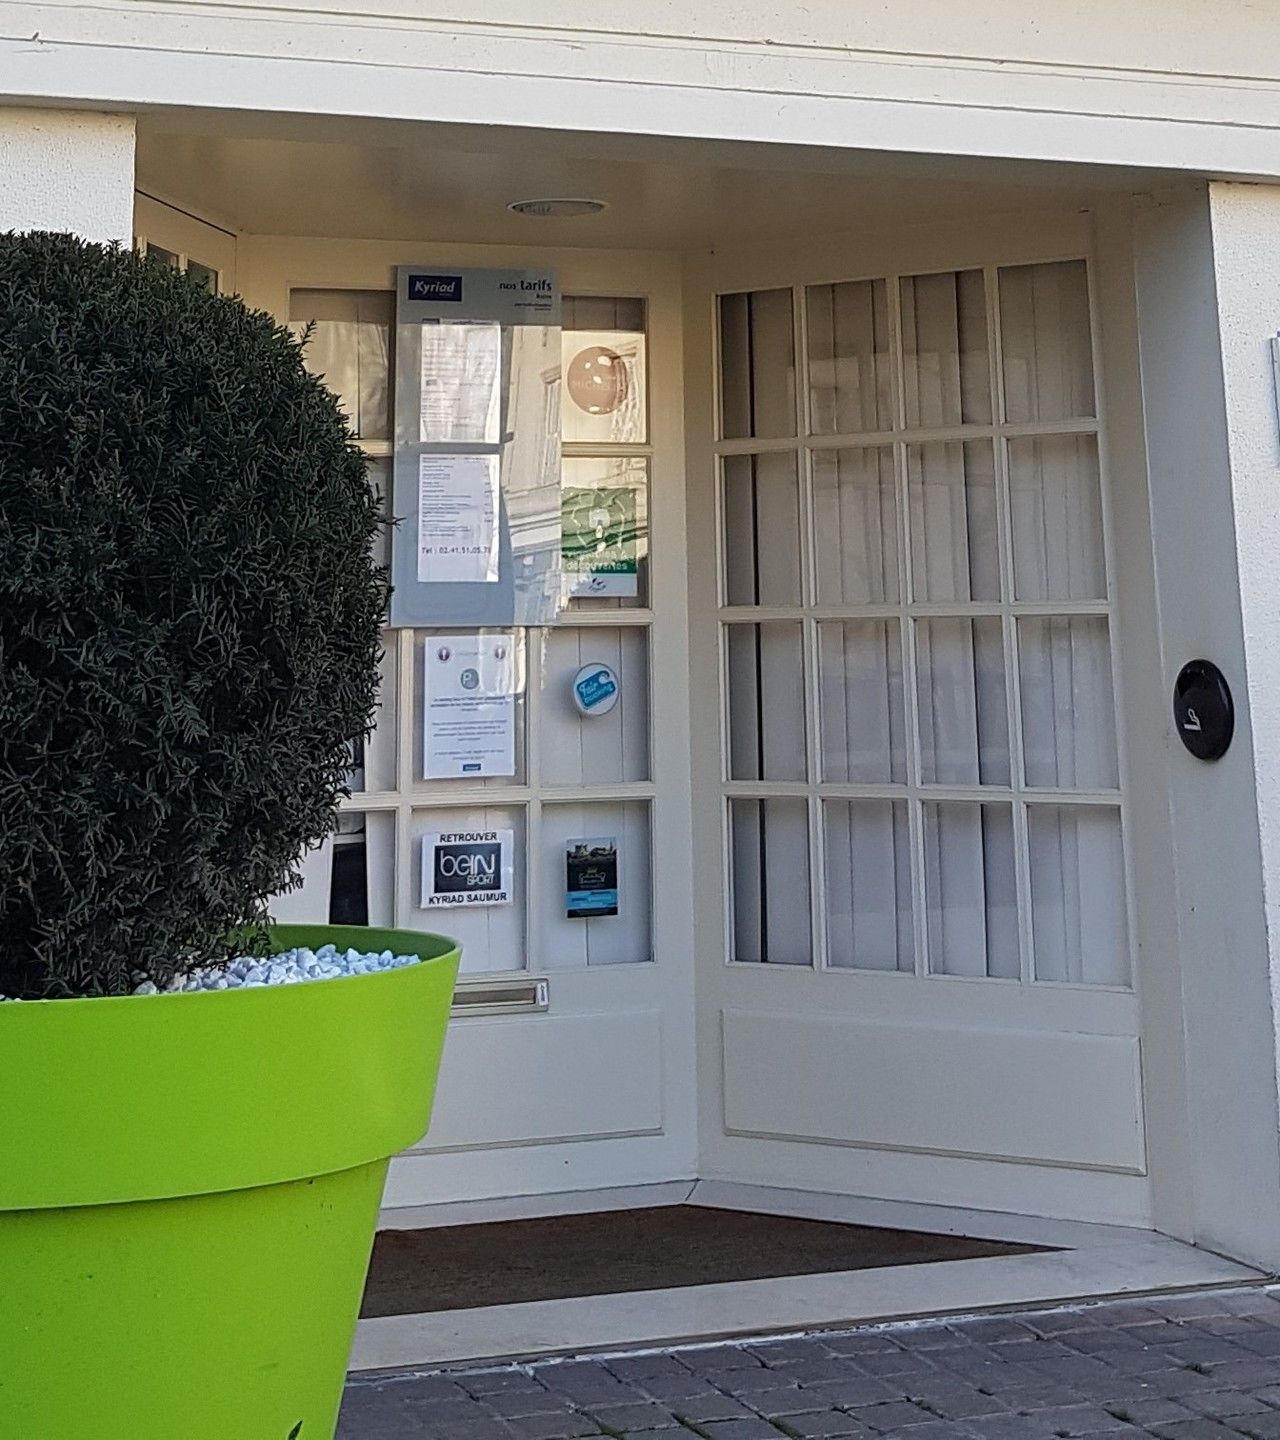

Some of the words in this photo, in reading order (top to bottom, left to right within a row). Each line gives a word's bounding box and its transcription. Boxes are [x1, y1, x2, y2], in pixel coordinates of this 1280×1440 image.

[414, 280, 456, 295] Kyriad
[499, 281, 517, 290] nos
[520, 279, 552, 291] tarifs
[440, 832, 497, 842] RETROUVER
[467, 874, 494, 885] SPORT
[428, 894, 464, 904] KYRIAD
[466, 892, 507, 902] SAUMUR
